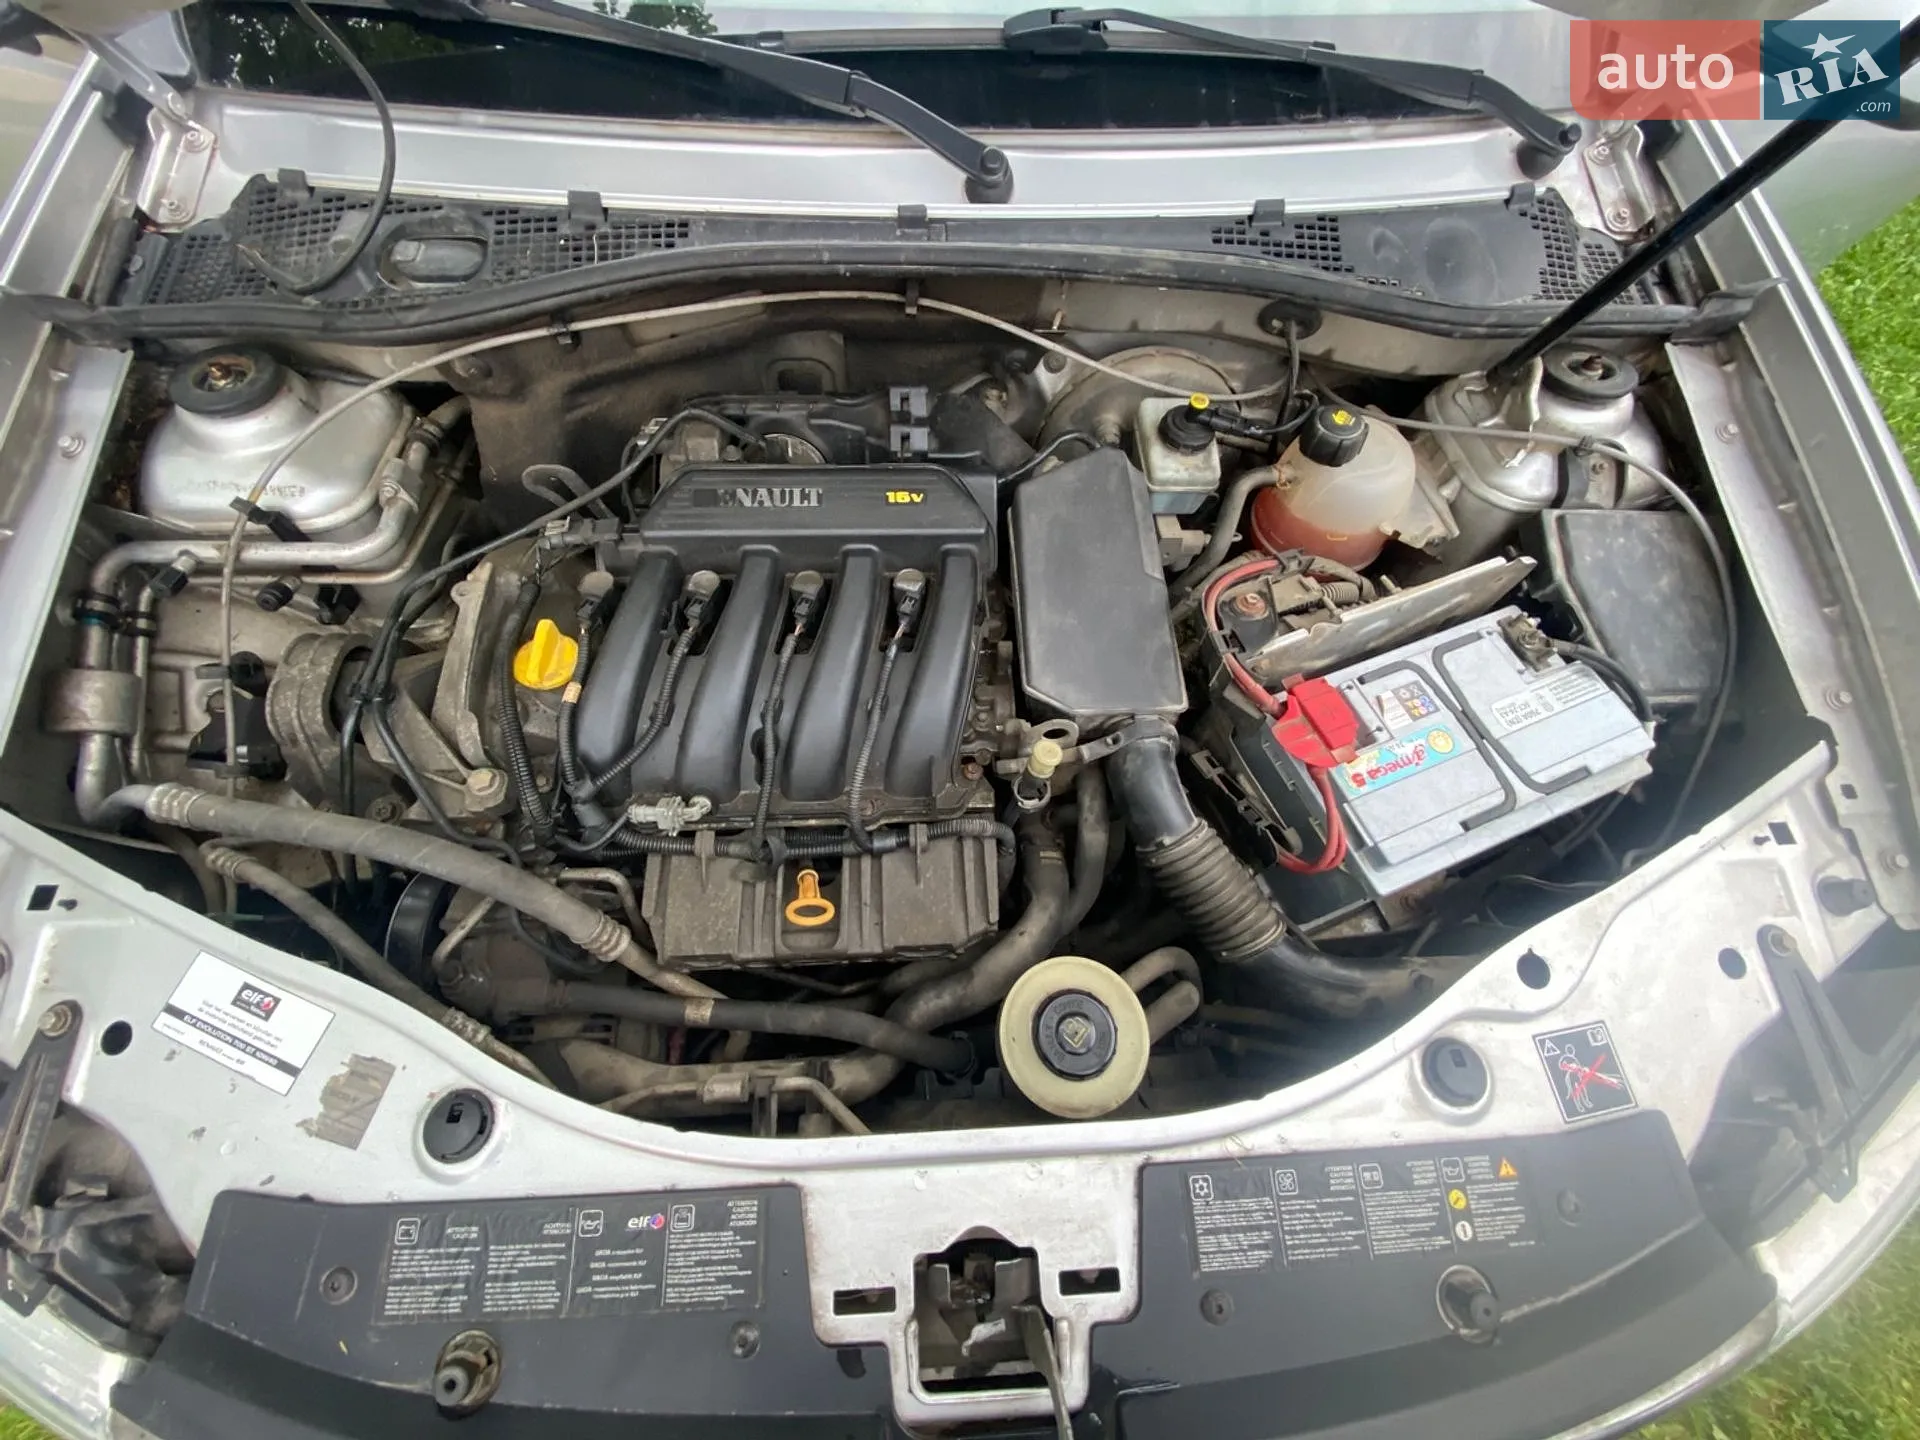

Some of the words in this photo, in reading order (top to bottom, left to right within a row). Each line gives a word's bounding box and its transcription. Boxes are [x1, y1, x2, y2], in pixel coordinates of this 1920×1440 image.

[694, 488, 823, 507] NAULT
[241, 987, 265, 1004] elf
[627, 1216, 651, 1228] elf
